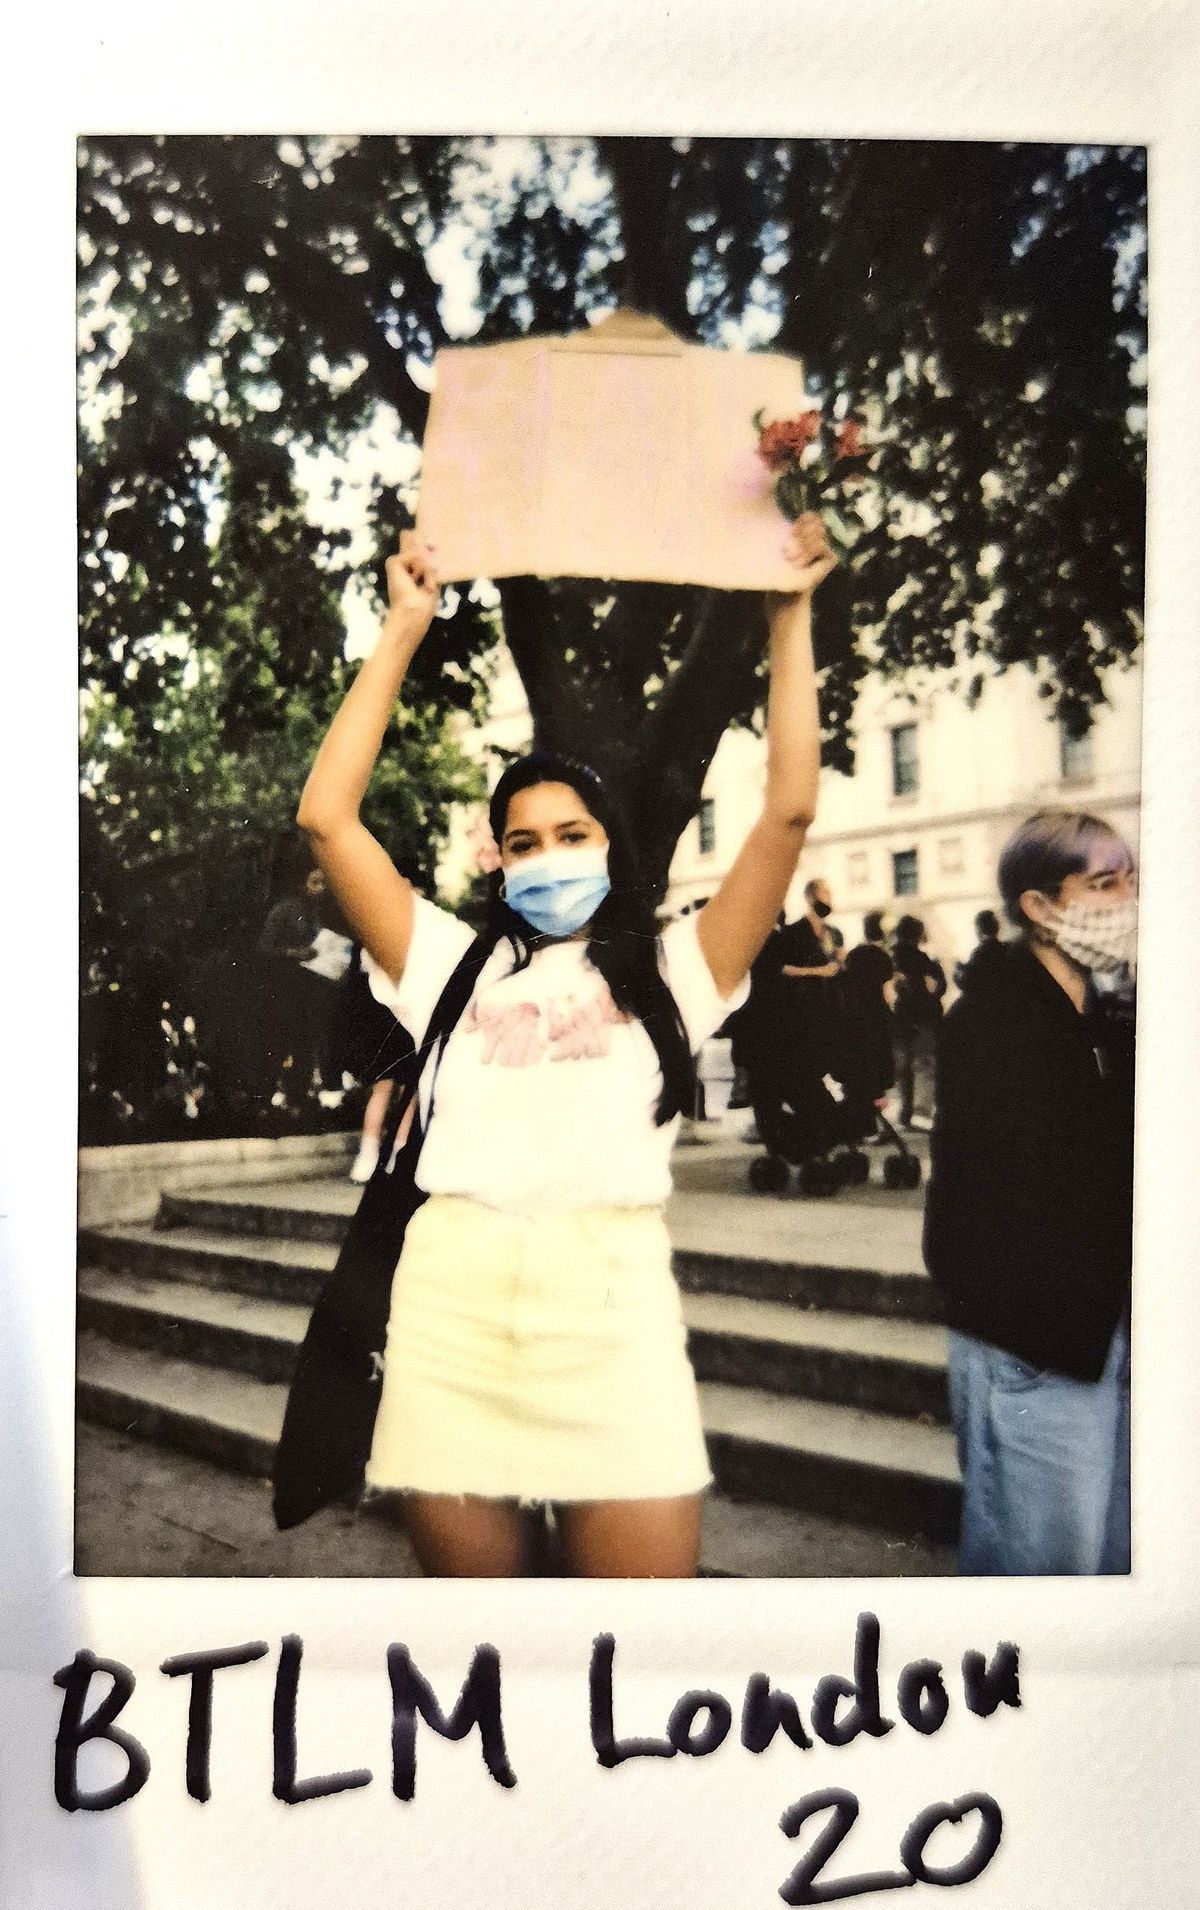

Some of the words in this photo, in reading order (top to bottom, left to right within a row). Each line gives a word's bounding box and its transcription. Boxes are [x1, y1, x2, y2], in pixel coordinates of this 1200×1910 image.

[52, 1633, 519, 1814] BTLM
[589, 1611, 1023, 1769] London
[778, 1786, 1004, 1907] 20
